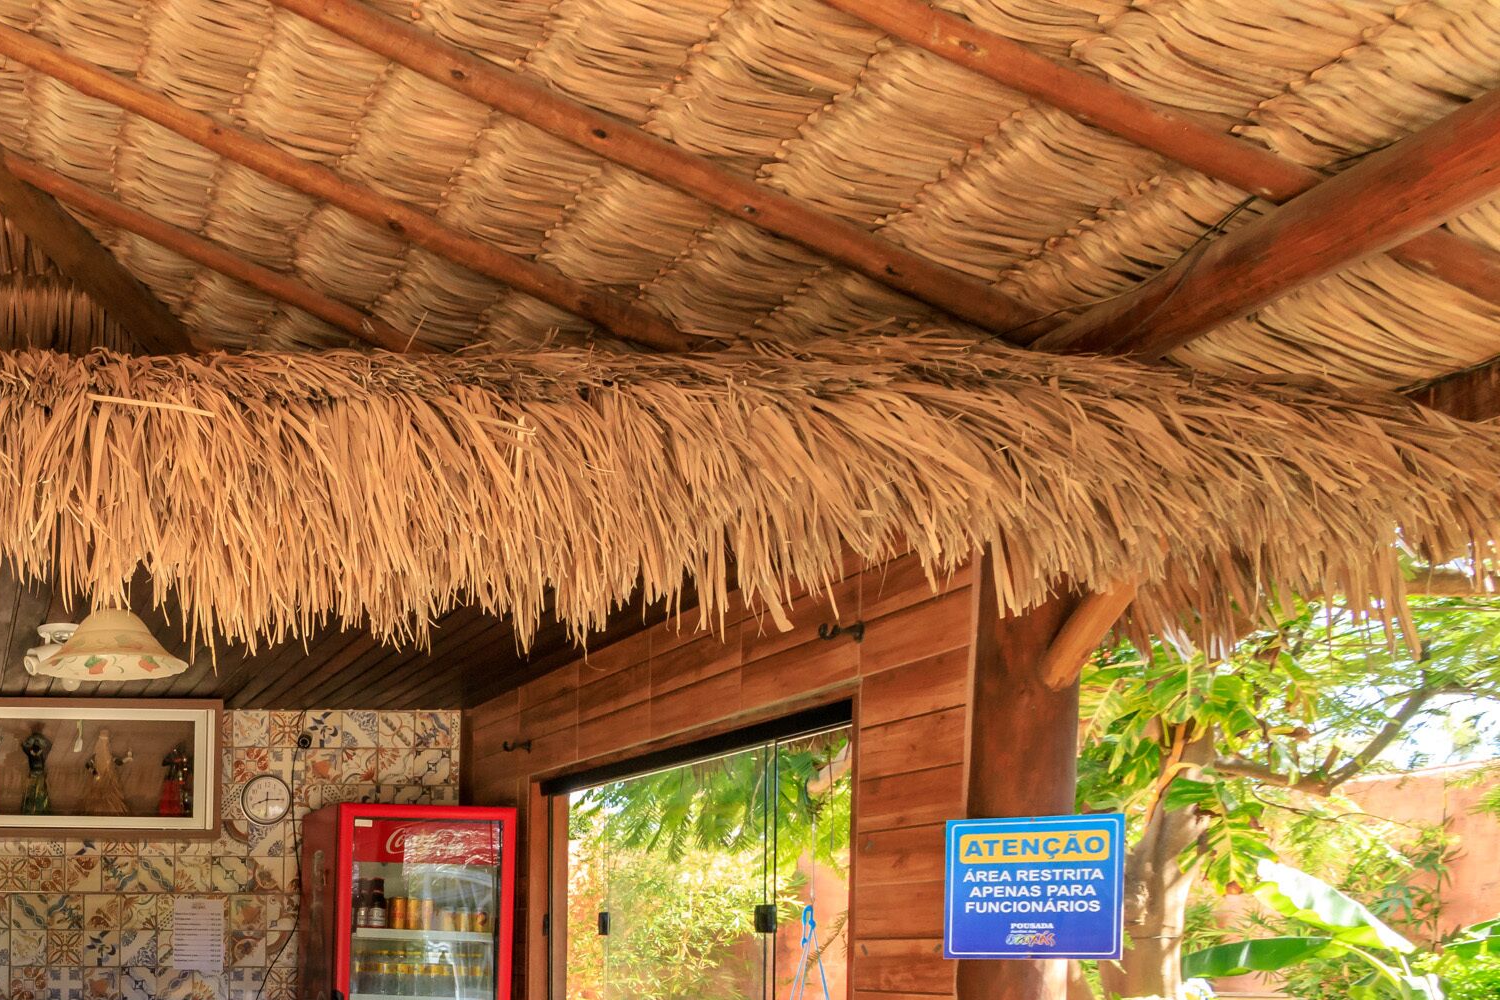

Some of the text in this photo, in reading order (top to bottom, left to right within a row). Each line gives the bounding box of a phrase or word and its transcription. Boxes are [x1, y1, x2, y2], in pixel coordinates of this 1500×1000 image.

[964, 833, 1105, 859] ATENÇÃO
[963, 868, 1104, 882] ÁREA RESTRITA
[969, 884, 1096, 898] APENAS PARA
[965, 898, 1100, 914] FUNCIONÁRIOS
